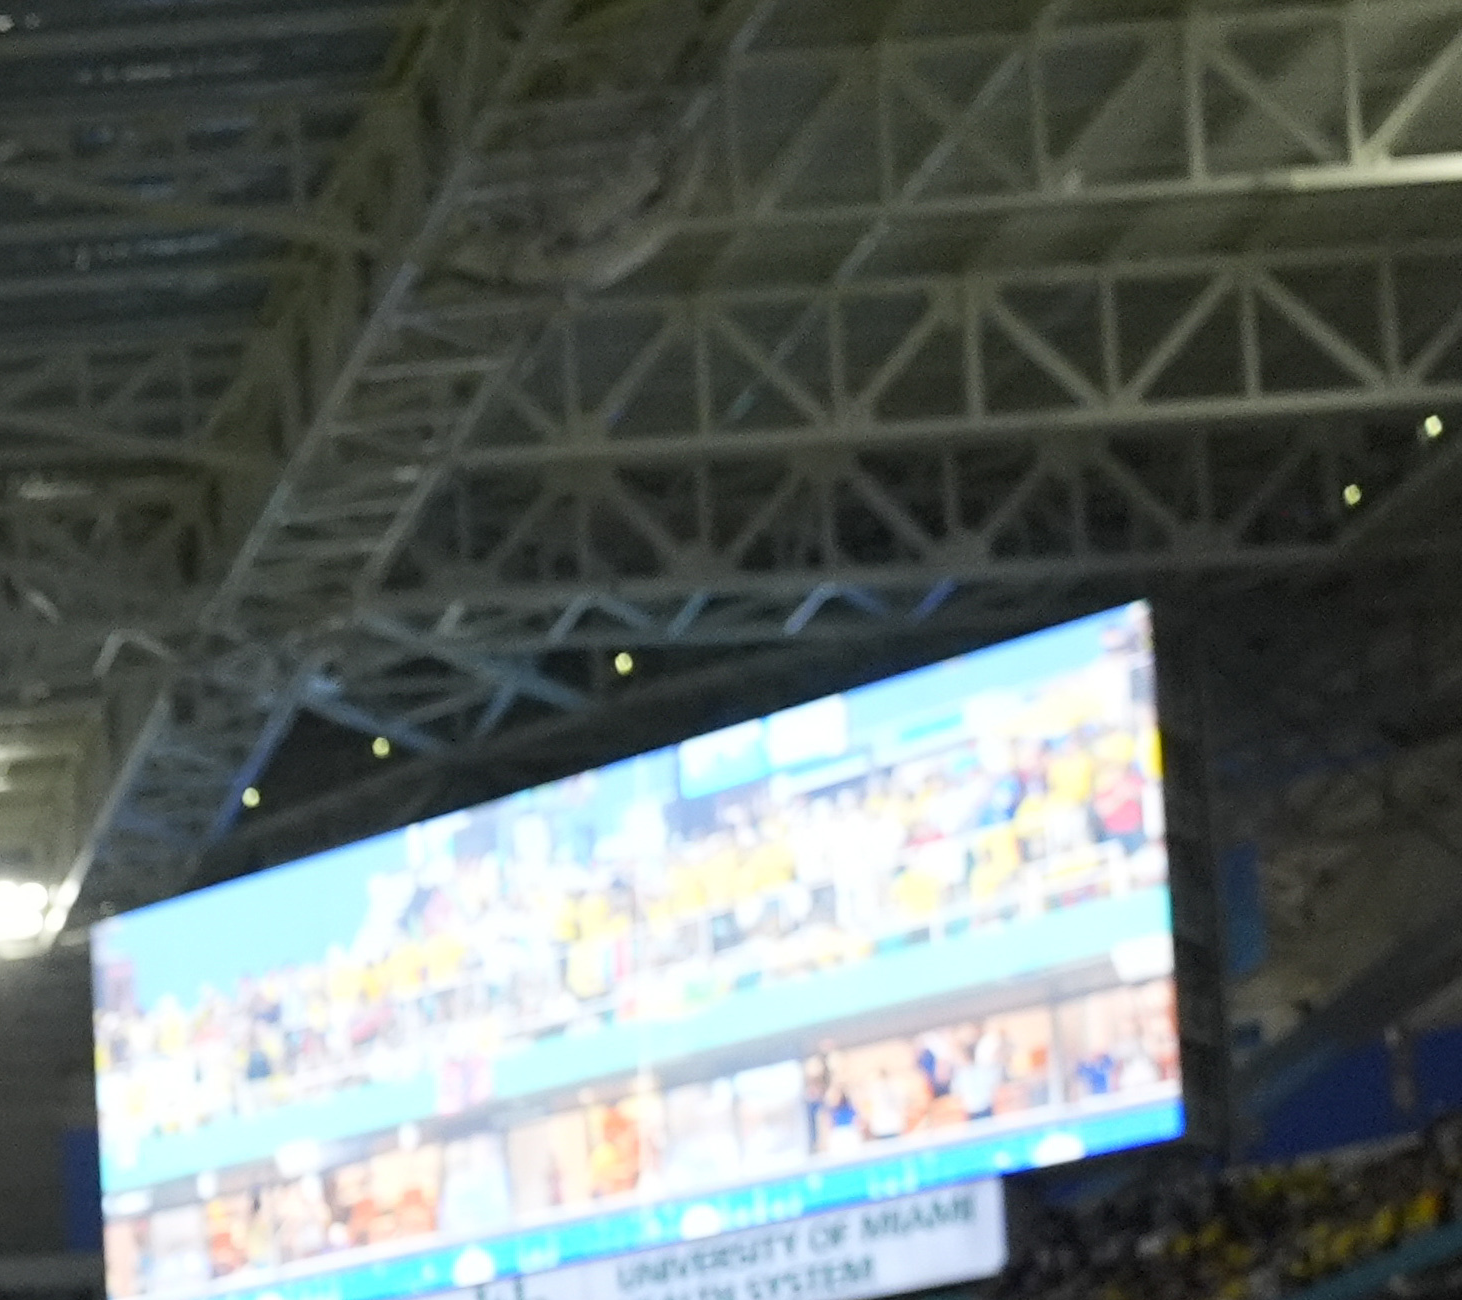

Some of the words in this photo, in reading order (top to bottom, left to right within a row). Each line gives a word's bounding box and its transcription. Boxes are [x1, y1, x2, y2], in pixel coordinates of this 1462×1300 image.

[617, 1230, 799, 1286] UNIVERSITY
[811, 1216, 855, 1249] OF
[861, 1192, 978, 1240] MIAMI
